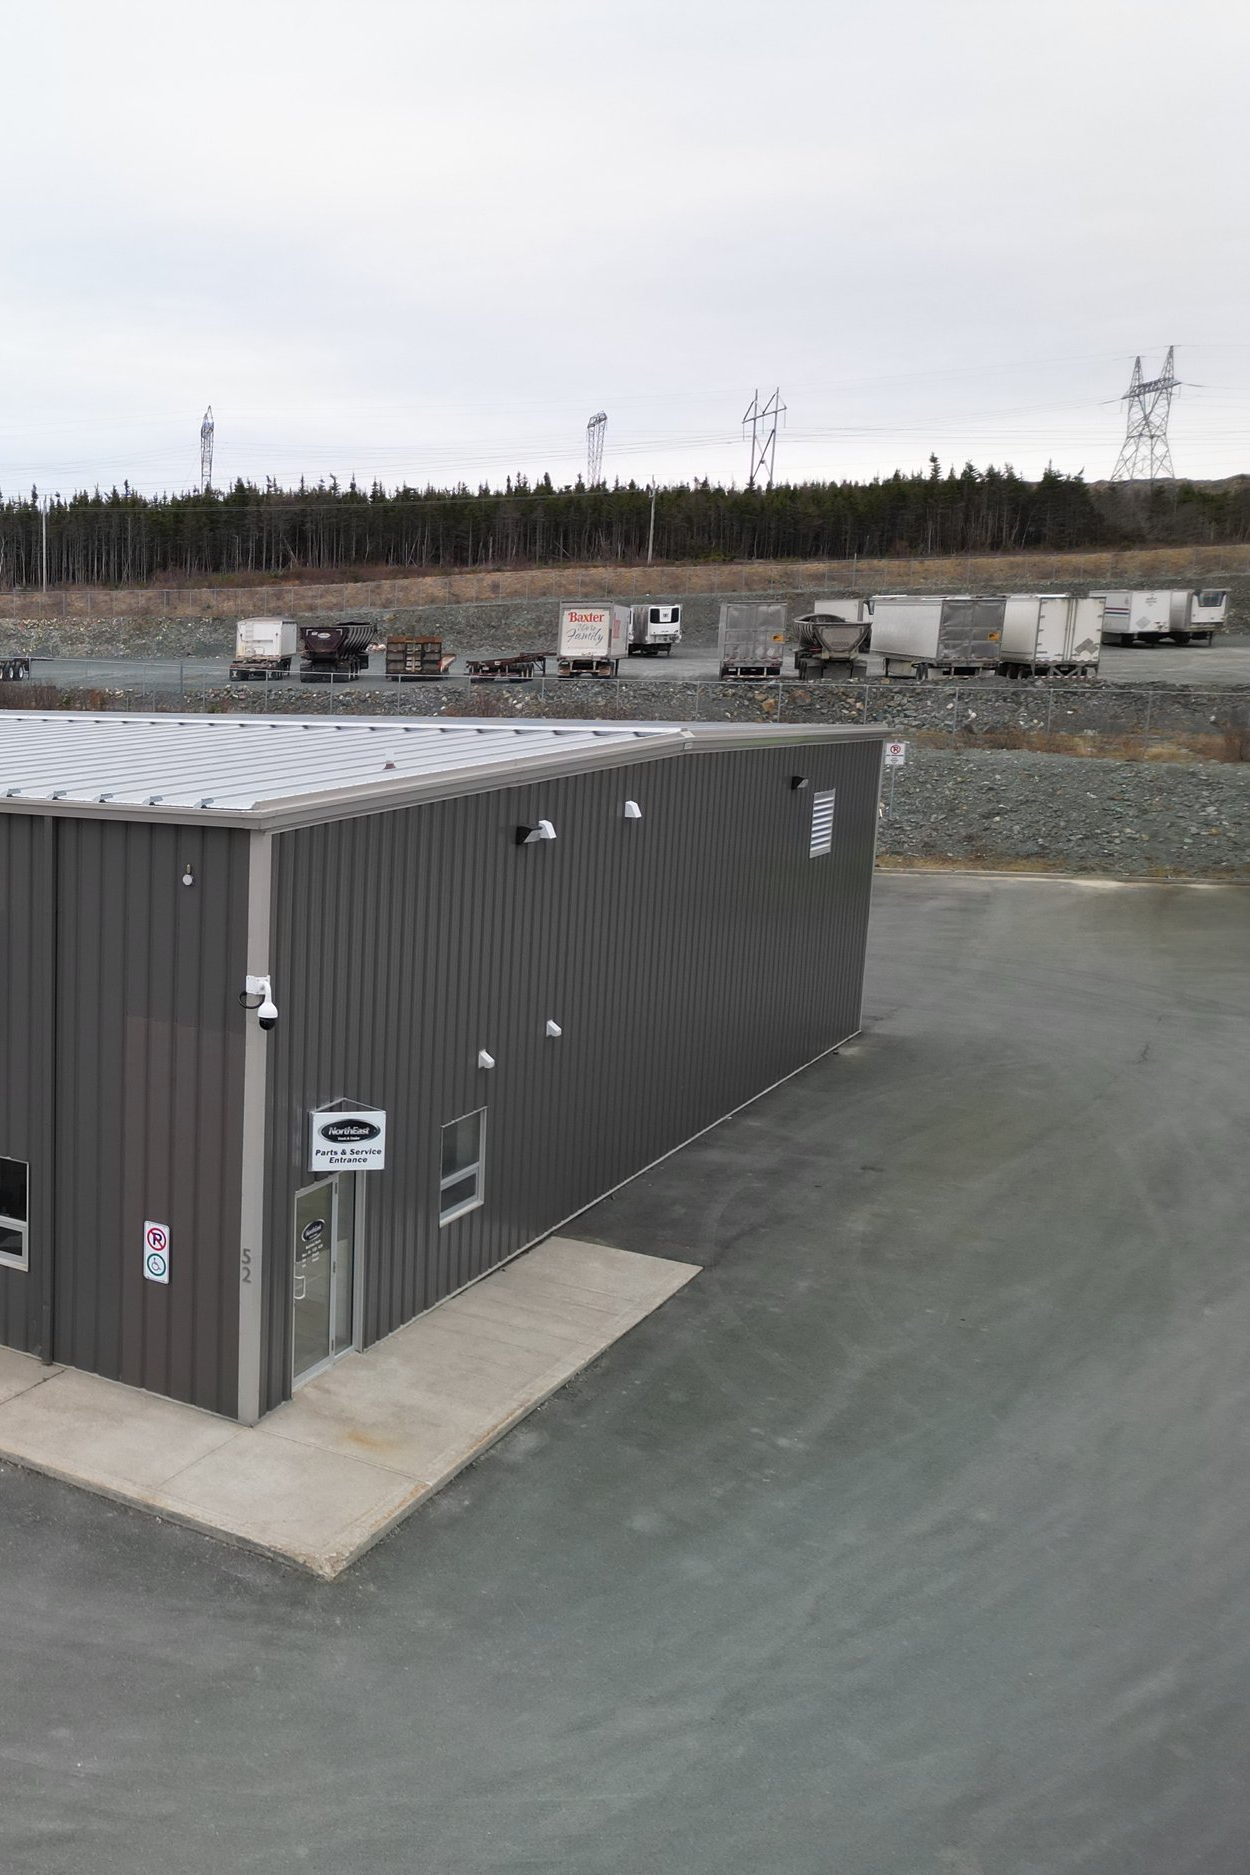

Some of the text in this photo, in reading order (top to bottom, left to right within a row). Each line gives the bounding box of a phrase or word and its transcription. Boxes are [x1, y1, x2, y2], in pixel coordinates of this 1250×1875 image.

[568, 611, 604, 623] Baxter
[566, 628, 604, 646] Family
[328, 1126, 370, 1136] NorthEast
[340, 1148, 347, 1156] &
[349, 1147, 382, 1156] Service
[328, 1156, 368, 1164] Entrance
